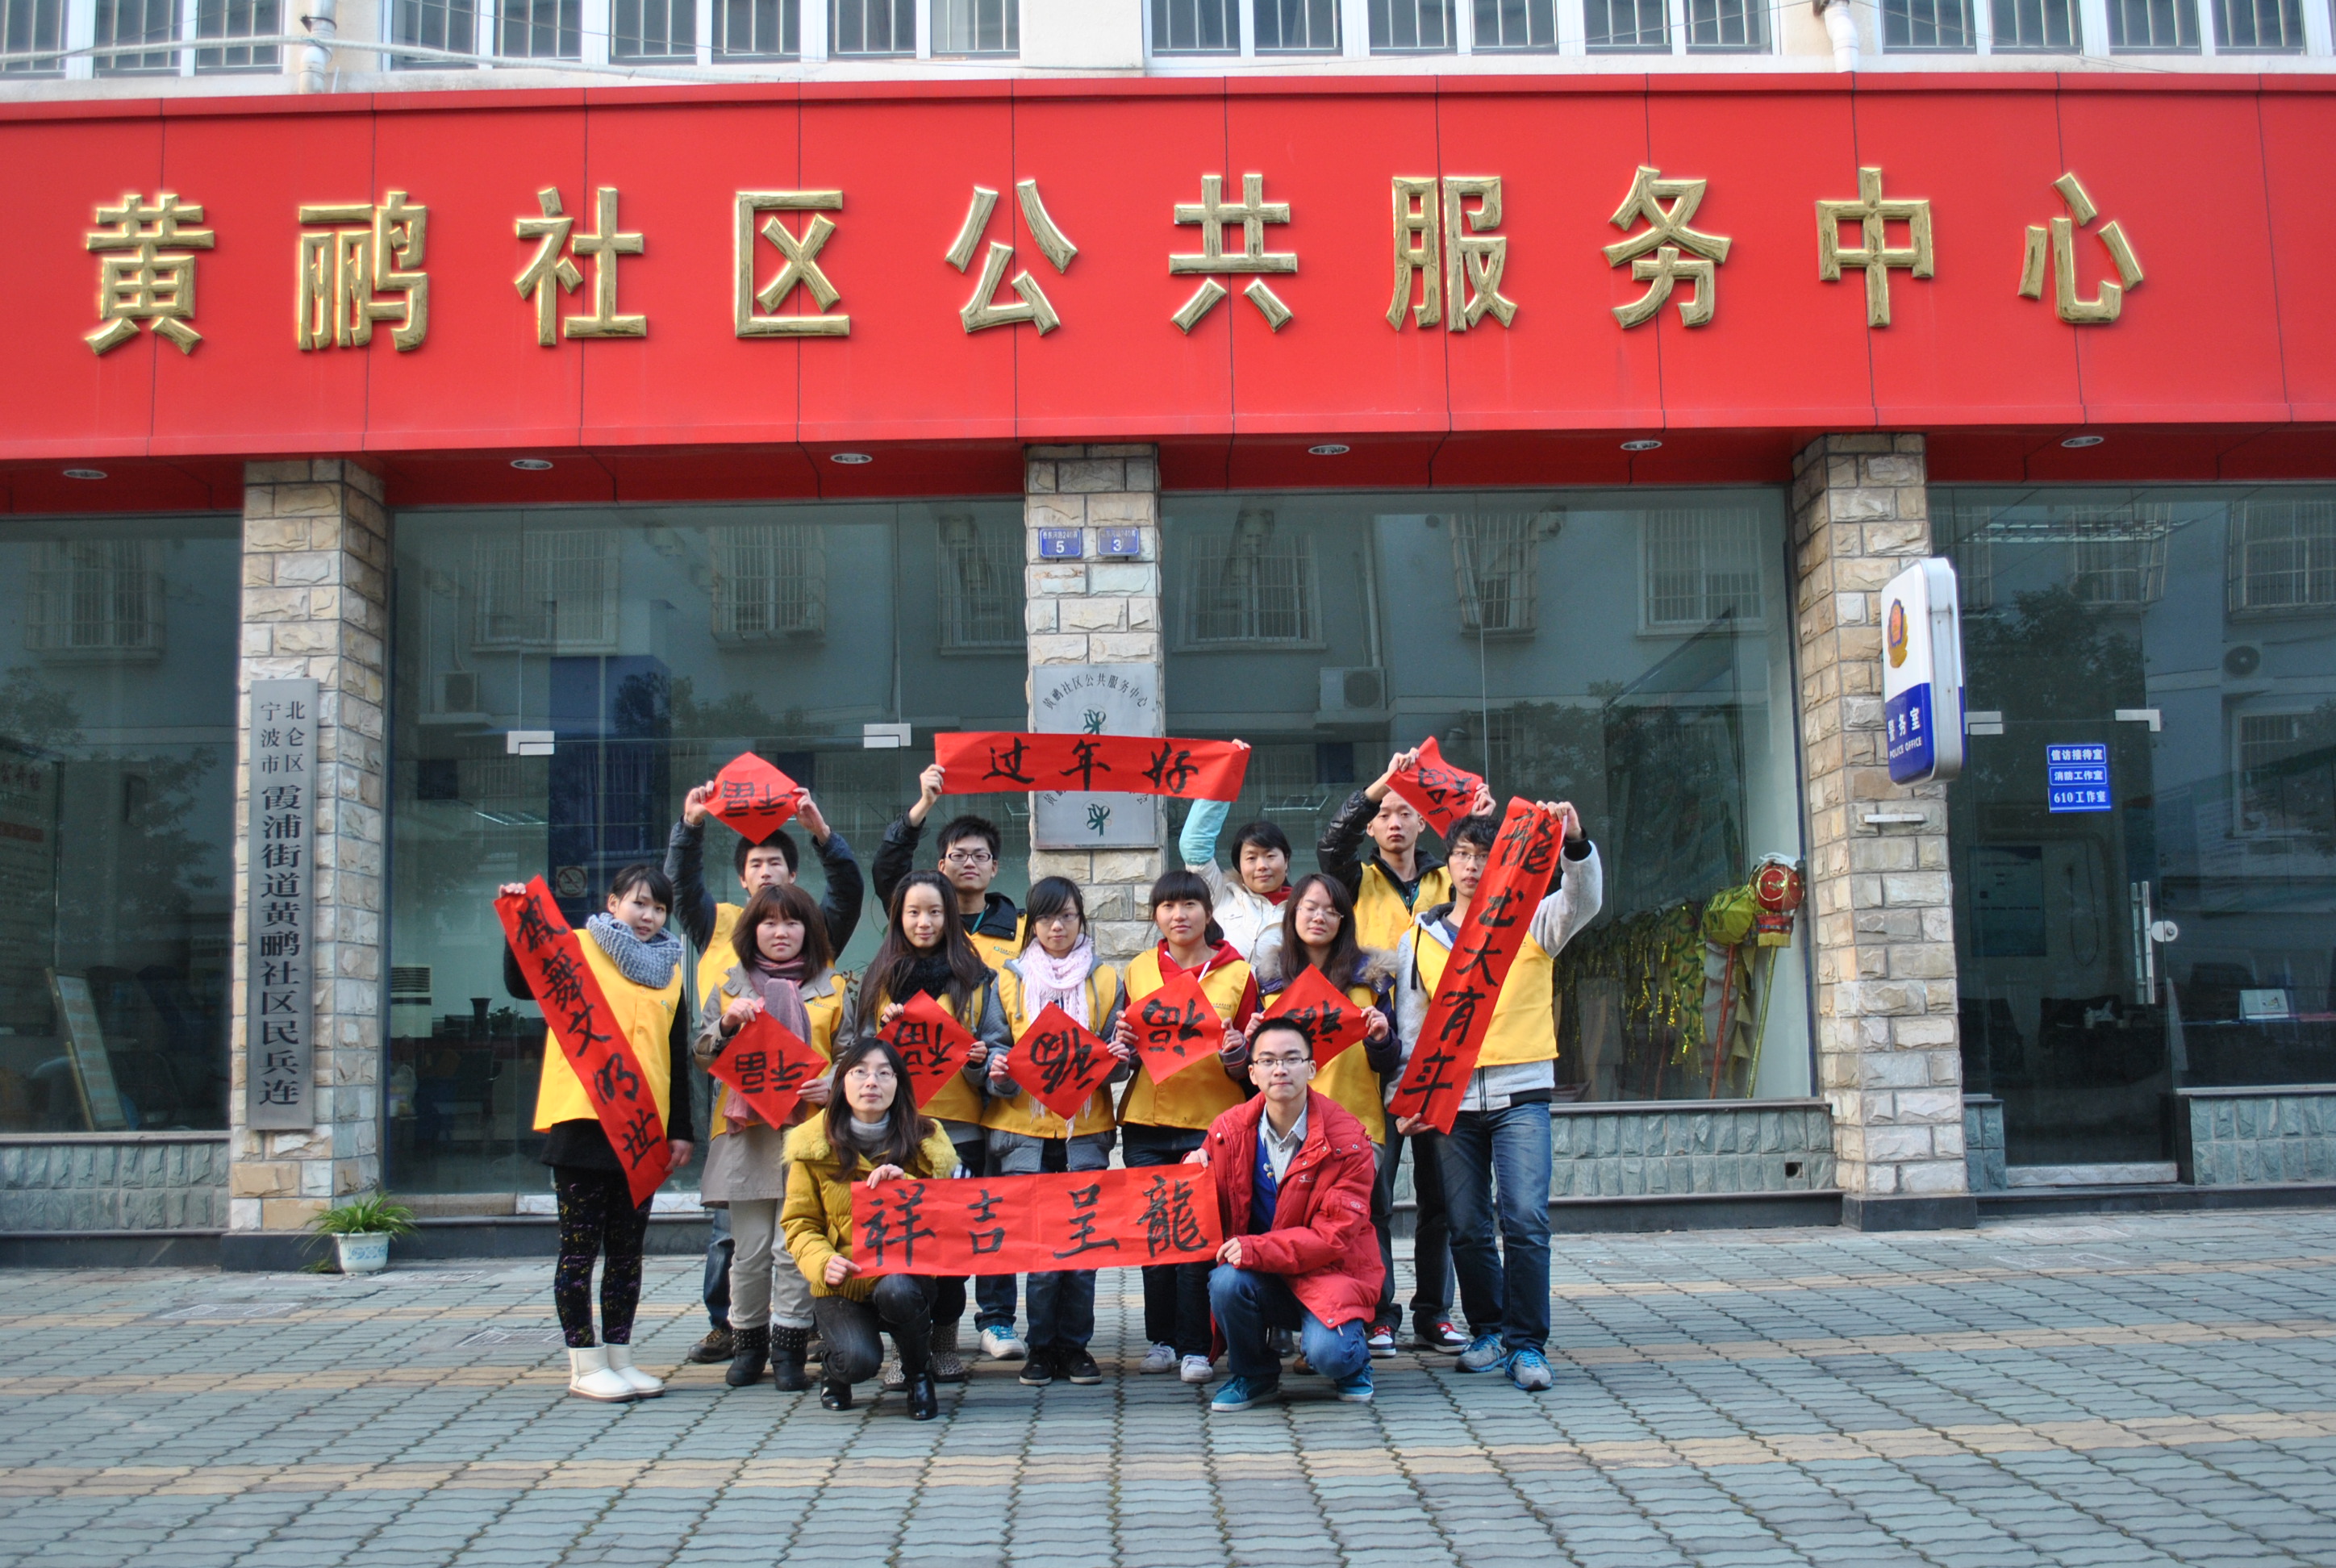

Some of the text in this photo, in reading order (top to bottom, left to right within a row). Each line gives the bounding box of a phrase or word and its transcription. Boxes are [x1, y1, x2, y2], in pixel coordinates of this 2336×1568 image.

[84, 165, 2144, 355] 黄鹂社区公共服务中心
[1056, 540, 1066, 554] 5
[1112, 539, 1123, 552] 3
[1042, 673, 1149, 710] 黄鹂社区公共服务中心
[260, 702, 281, 775] 宁波市
[285, 701, 306, 774] 北仑区
[1888, 707, 1921, 743] 警务室
[981, 736, 1199, 795] 过年好
[1889, 736, 1922, 760] POLICE OFFICE
[2050, 749, 2104, 761] 信访接待室
[2054, 770, 2104, 782] 消防工作室
[720, 779, 794, 818] 福
[2053, 790, 2106, 804] 610工作室
[258, 784, 303, 1107] 霞浦街道黄鹂社区民兵连
[1141, 999, 1206, 1057] 福
[892, 1020, 955, 1076] 福
[735, 1049, 809, 1095] 福
